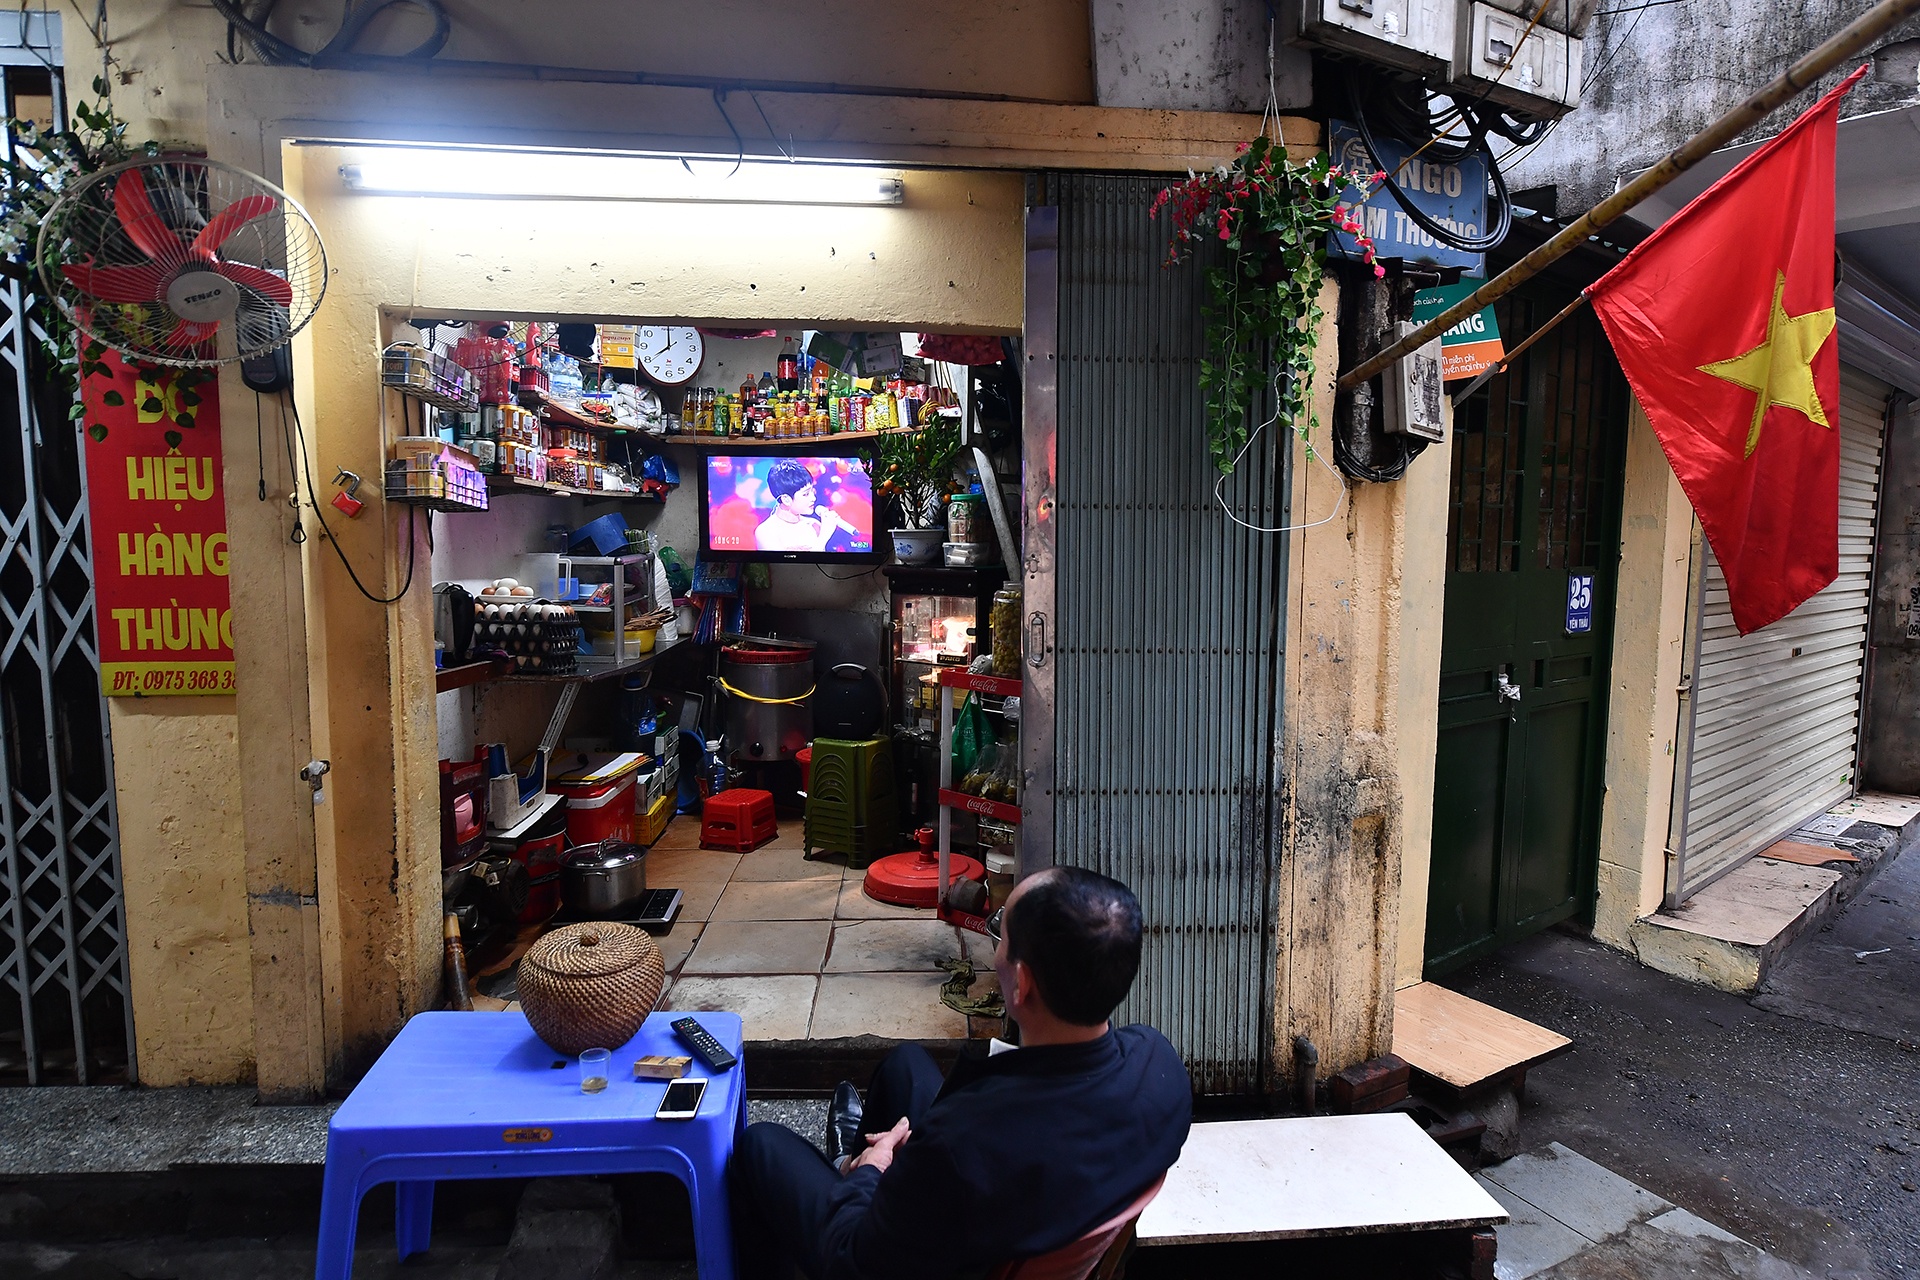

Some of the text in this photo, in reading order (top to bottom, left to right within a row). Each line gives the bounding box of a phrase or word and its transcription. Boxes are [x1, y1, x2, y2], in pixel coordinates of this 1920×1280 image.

[184, 289, 222, 304] SENKO
[643, 330, 654, 338] 10
[685, 332, 694, 340] 2
[640, 342, 648, 350] 9
[644, 356, 652, 364] 8
[653, 366, 660, 374] 7
[665, 370, 673, 378] 6
[677, 367, 685, 375] 5
[126, 448, 214, 511] HIỆU
[118, 523, 229, 576] HÀNG
[1569, 577, 1590, 609] 25
[113, 670, 140, 690] ĐT:
[143, 670, 185, 690] 0975
[187, 670, 219, 690] 368
